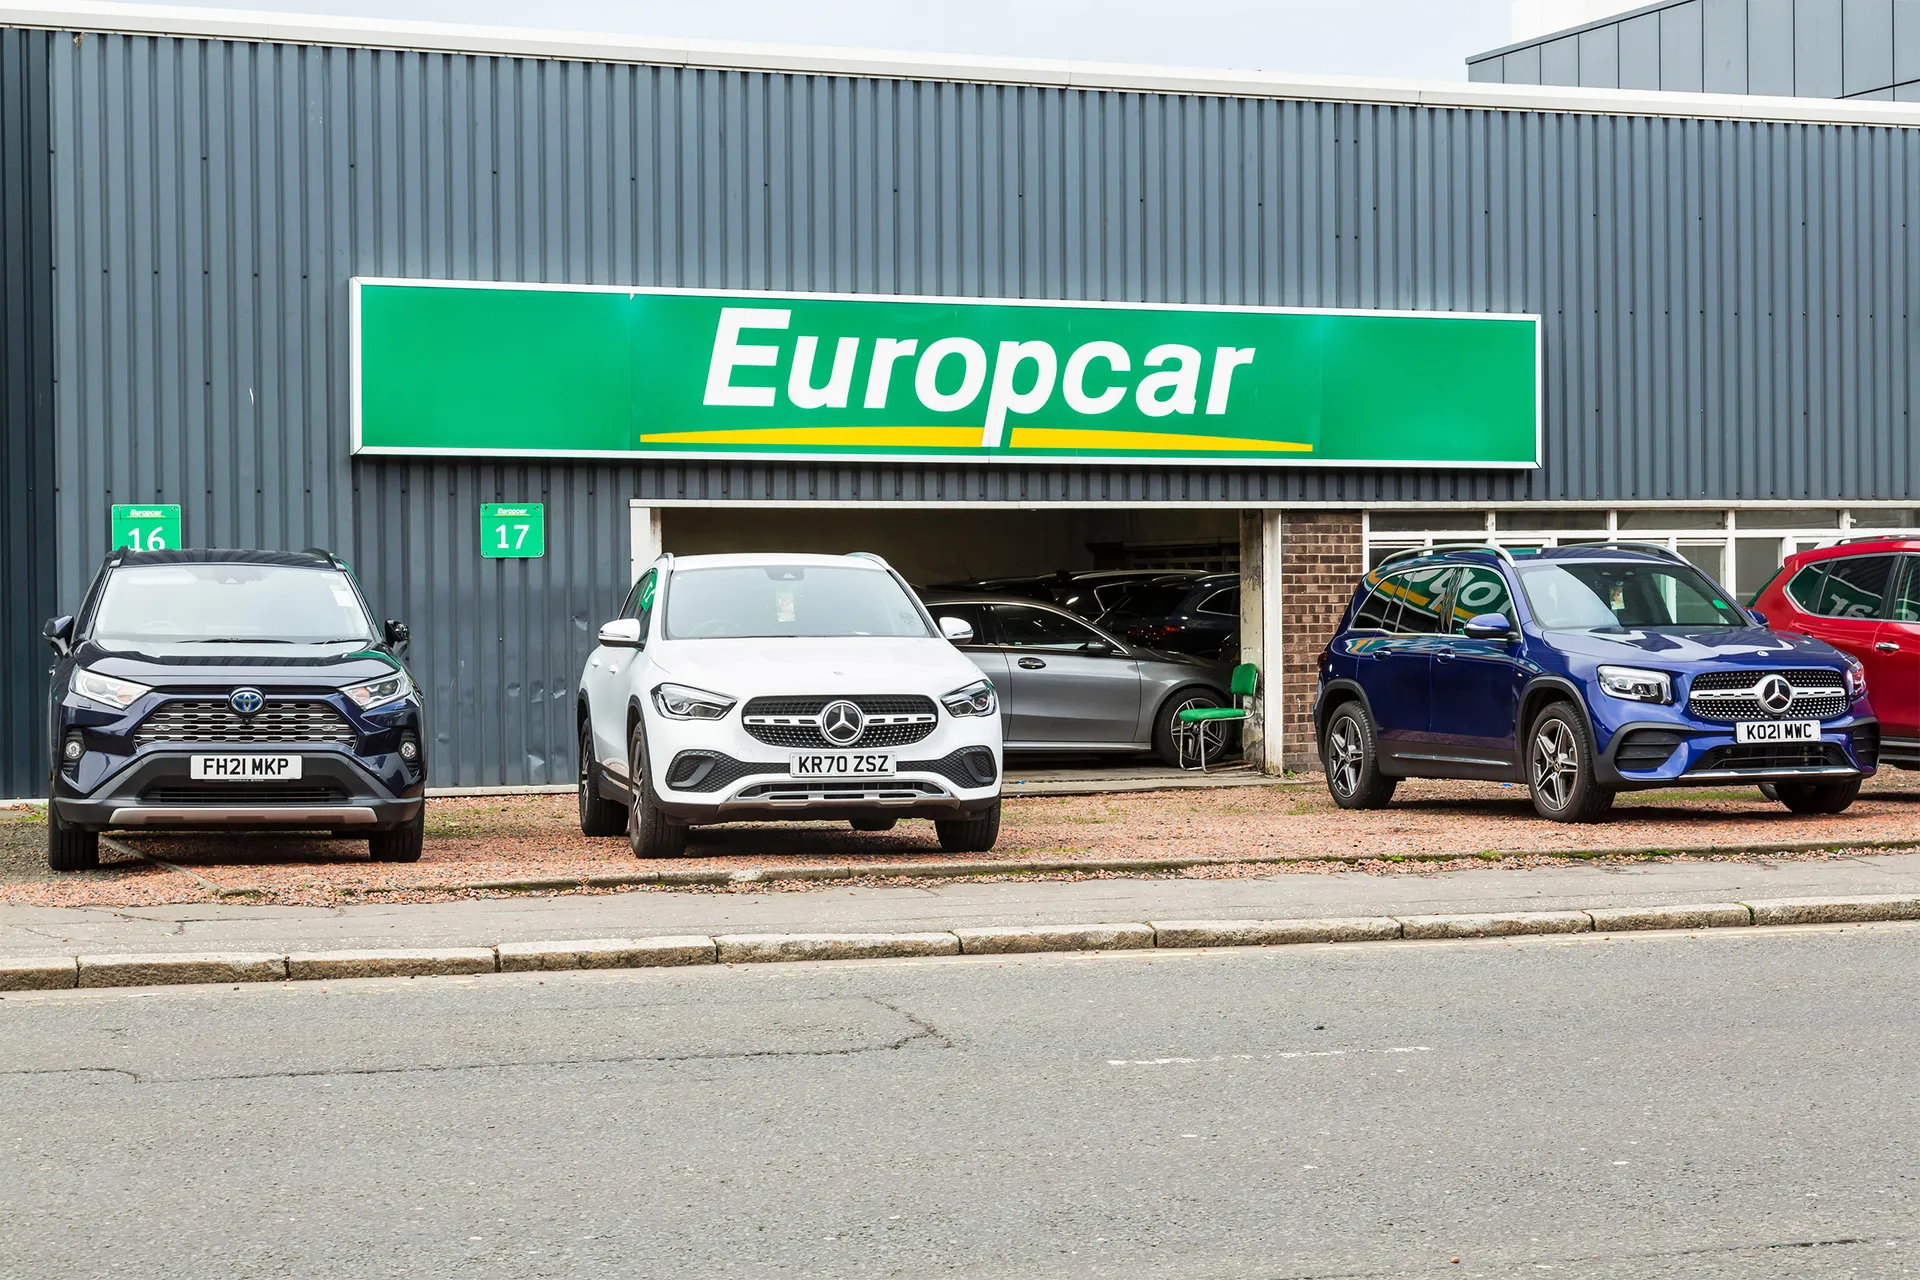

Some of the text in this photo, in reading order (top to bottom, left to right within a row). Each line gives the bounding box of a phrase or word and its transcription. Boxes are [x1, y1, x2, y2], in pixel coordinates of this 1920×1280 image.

[703, 307, 1256, 448] Europcar
[130, 509, 163, 517] Europcar
[497, 507, 527, 515] Europcar
[128, 526, 166, 552] 16
[495, 524, 530, 550] 17
[1784, 723, 1812, 739] MWC
[203, 758, 289, 775] FH21 MKP
[798, 755, 889, 773] KR70 ZSZ
